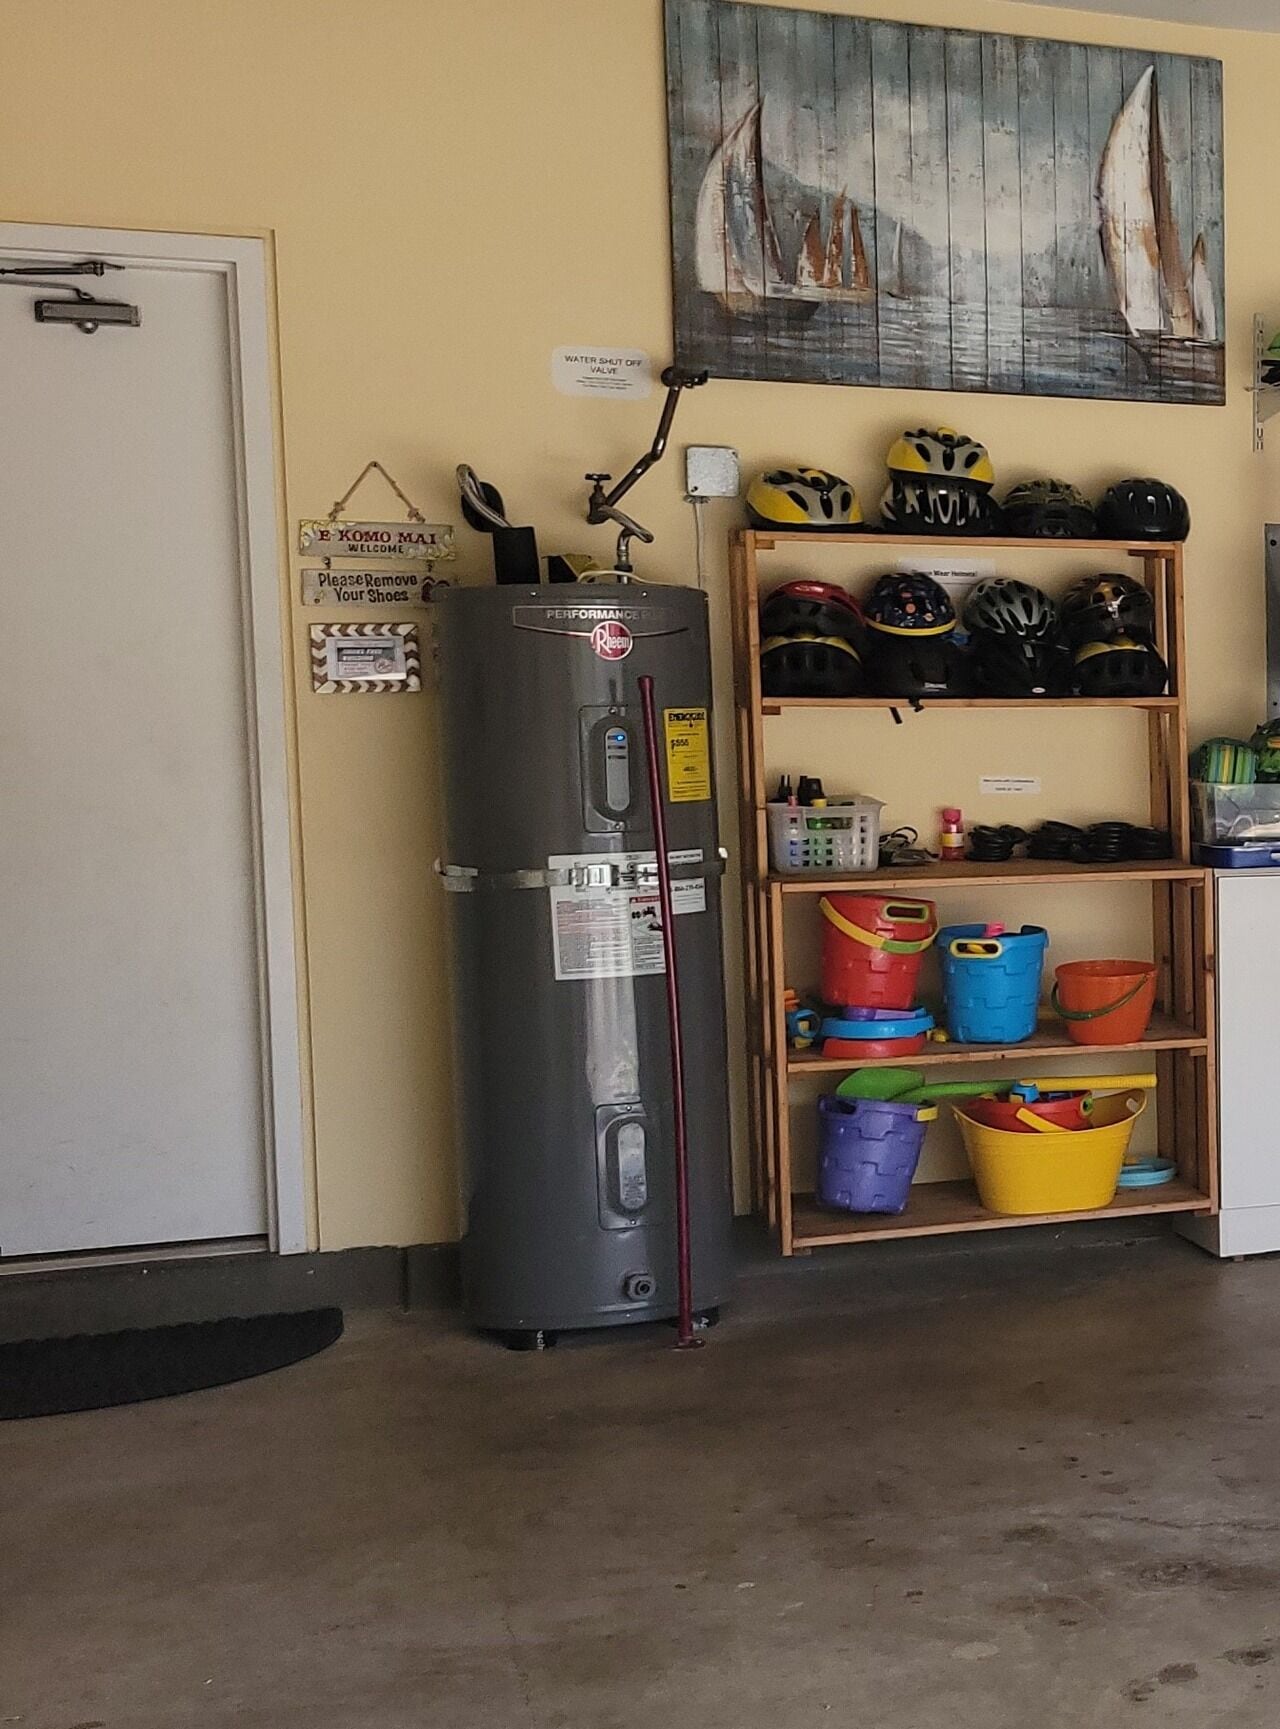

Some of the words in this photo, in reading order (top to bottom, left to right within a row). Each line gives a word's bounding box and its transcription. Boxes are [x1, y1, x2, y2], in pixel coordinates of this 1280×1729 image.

[564, 355, 597, 364] WATER
[599, 357, 623, 366] SHUT
[625, 359, 643, 367] OFF
[590, 366, 618, 375] VALVE
[317, 529, 332, 542] E
[337, 530, 391, 543] KOMO
[397, 532, 437, 545] MAI
[348, 543, 405, 554] WELCOME
[318, 572, 364, 588] Please
[364, 573, 418, 588] Remove
[333, 587, 366, 603] Your
[367, 588, 409, 604] Shoes
[546, 609, 640, 620] PERFORMANCE
[595, 623, 630, 654] Rheem
